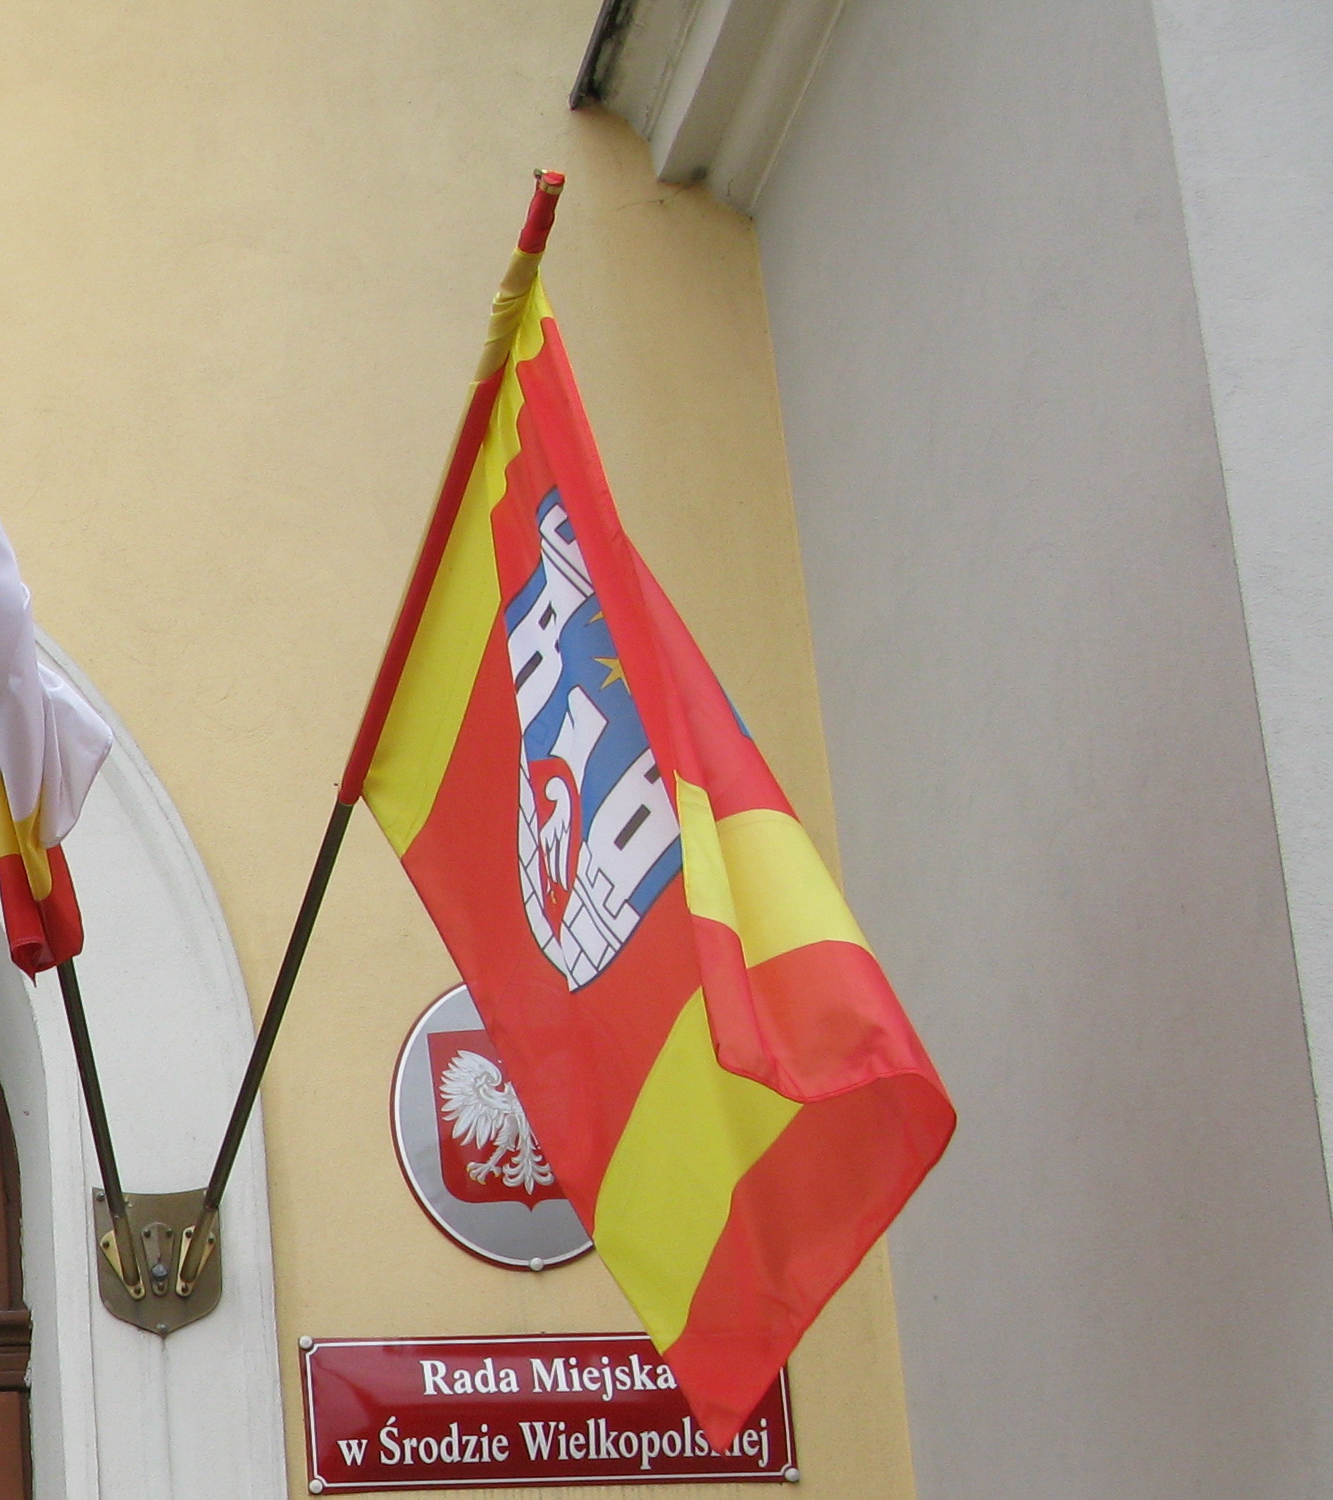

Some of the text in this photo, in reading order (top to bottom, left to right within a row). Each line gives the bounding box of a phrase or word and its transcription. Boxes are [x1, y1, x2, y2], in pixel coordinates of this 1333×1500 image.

[419, 1353, 678, 1402] Rada Miejska
[337, 1415, 769, 1470] w Środzie Wielkopolsiej
